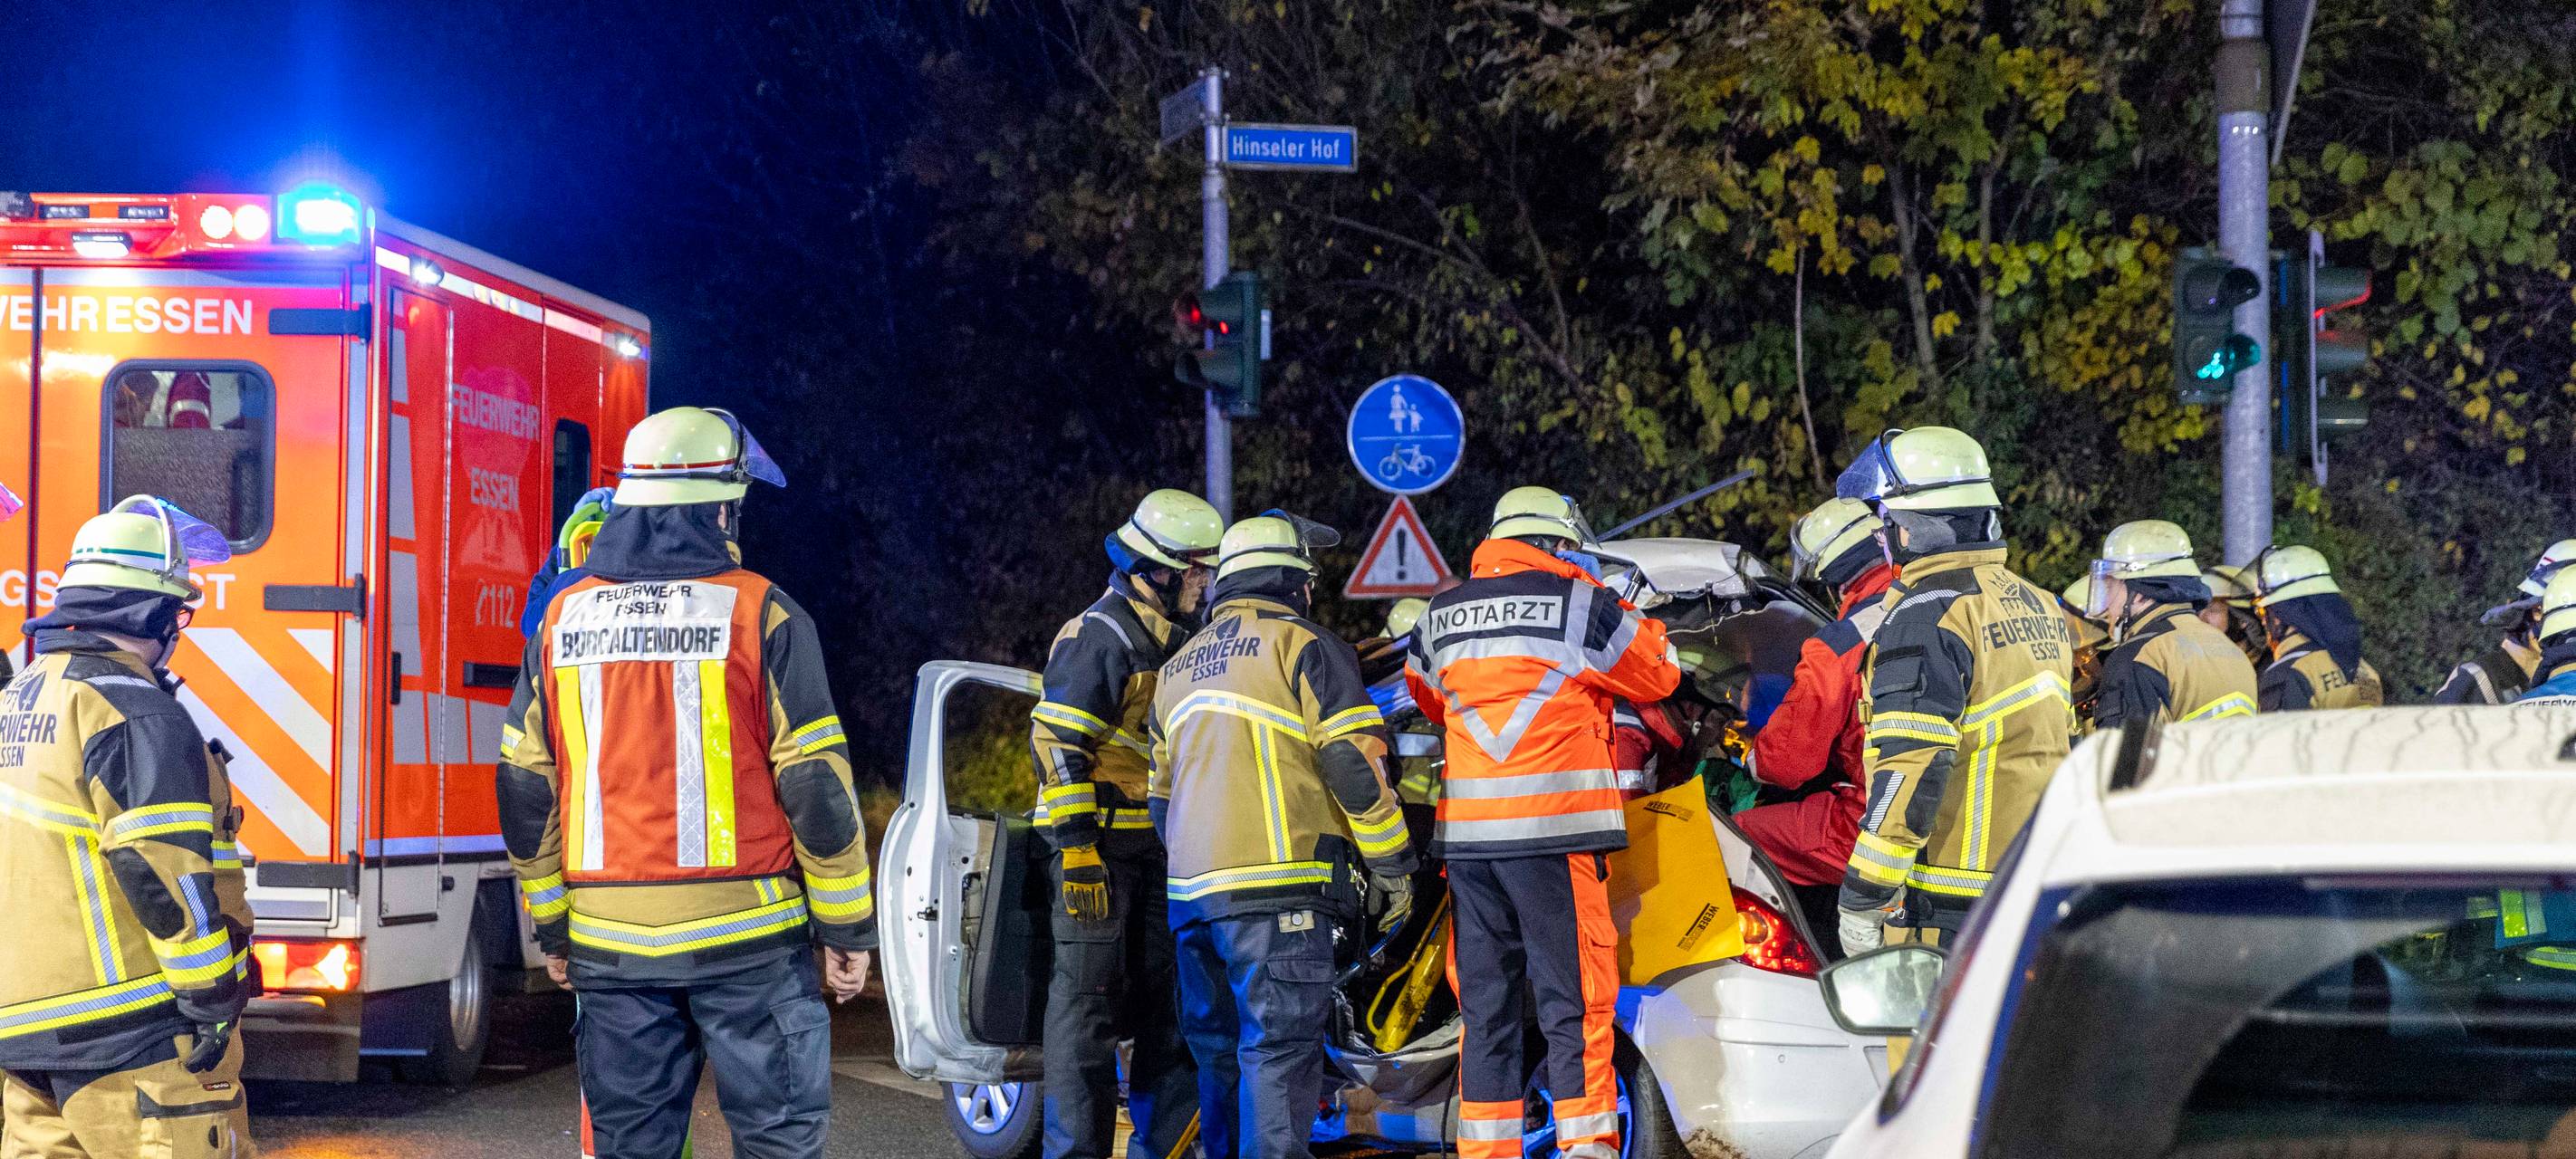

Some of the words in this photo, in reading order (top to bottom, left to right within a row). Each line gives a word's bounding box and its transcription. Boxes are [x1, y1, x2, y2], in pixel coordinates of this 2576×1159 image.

[1233, 135, 1305, 158] Hinseler
[1312, 138, 1340, 158] Hof
[0, 295, 100, 331] EHR
[106, 296, 253, 334] ESSEN
[453, 384, 540, 441] FEUERWEHR
[470, 467, 519, 512] ESSEN
[490, 585, 514, 628] 112
[596, 585, 692, 603] FEUERWEHR
[616, 601, 667, 617] ESSEN
[1437, 601, 1555, 632] NOTARZT
[562, 627, 721, 658] BURGALTENDORF
[1981, 616, 2069, 652] FEUERWEHR
[1164, 637, 1261, 685] FEUERWEHR
[2031, 641, 2061, 661] ESSEN
[1191, 658, 1227, 683] ESSEN
[1697, 905, 1720, 931] WEBER
